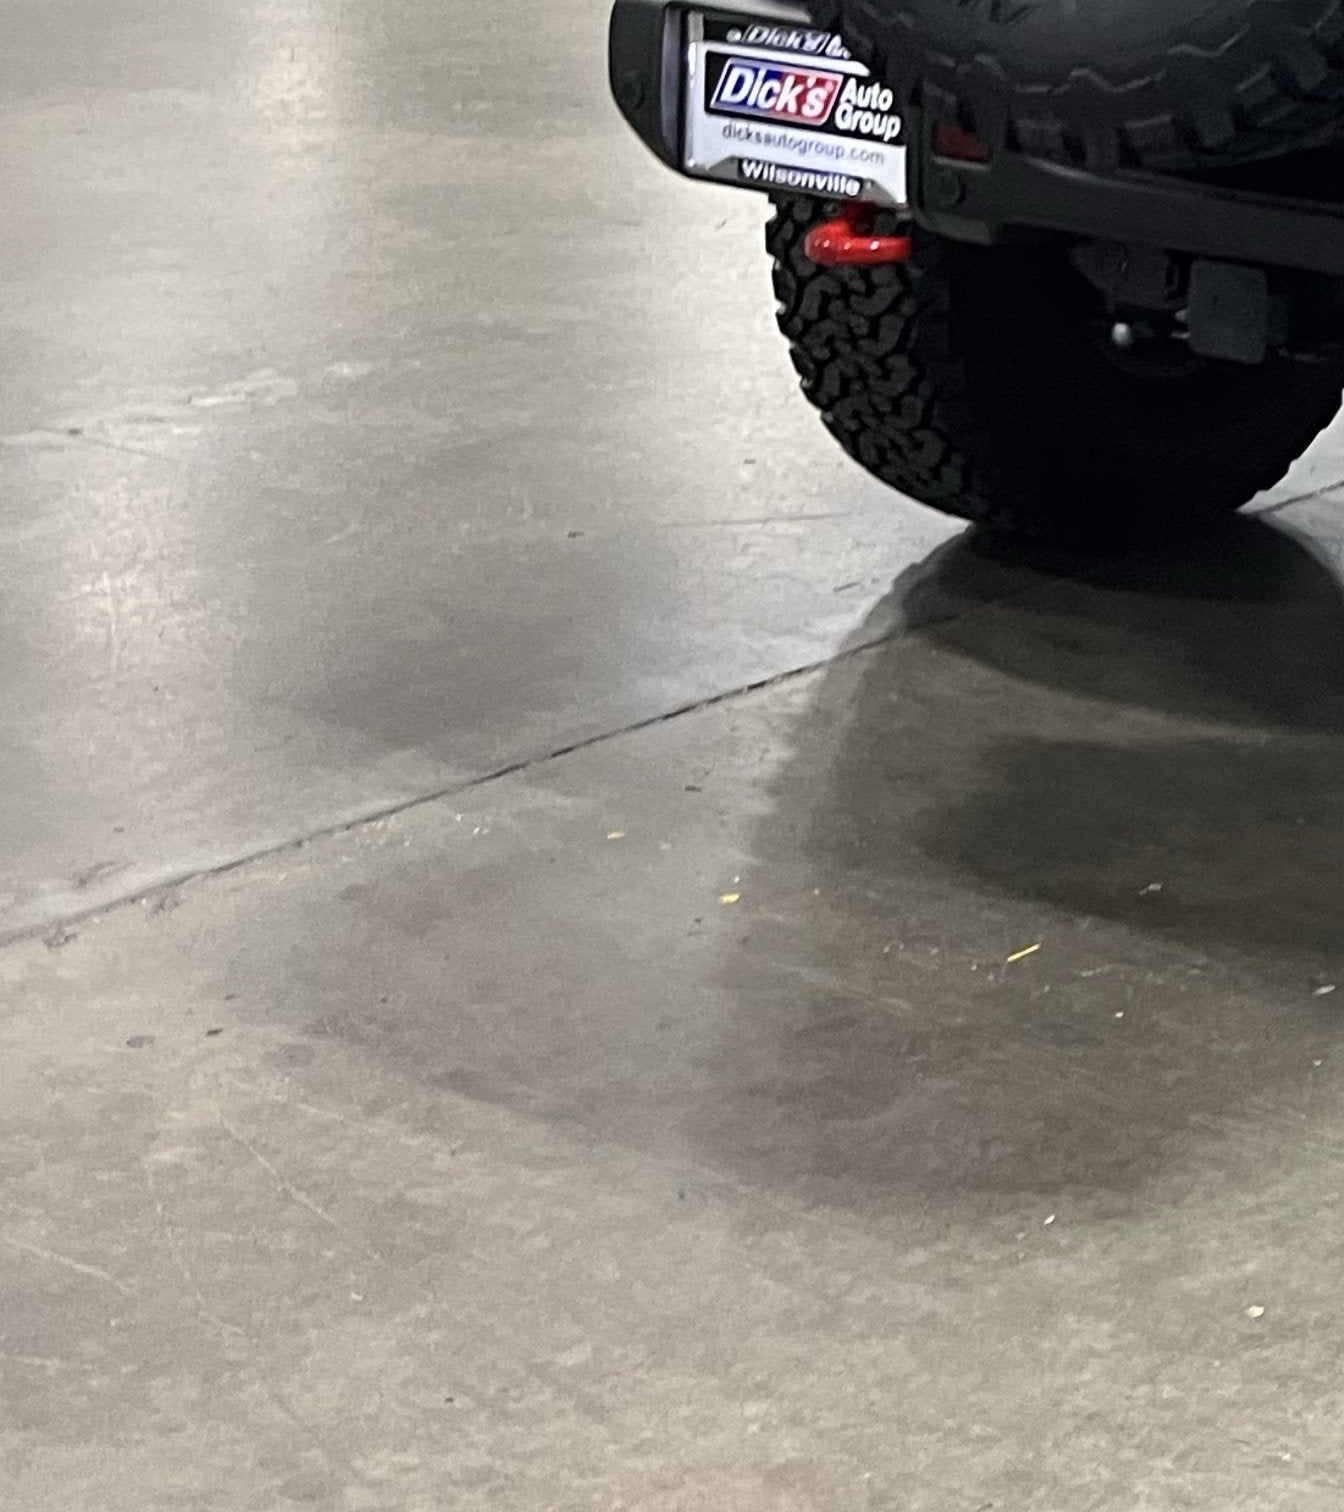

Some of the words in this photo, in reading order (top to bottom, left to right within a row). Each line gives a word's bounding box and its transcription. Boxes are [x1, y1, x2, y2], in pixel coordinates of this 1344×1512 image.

[720, 66, 831, 117] Dick's
[840, 77, 893, 111] Auto
[835, 103, 901, 142] Group
[722, 123, 885, 165] dicksautogroup.com
[741, 159, 861, 197] Wilsonville
